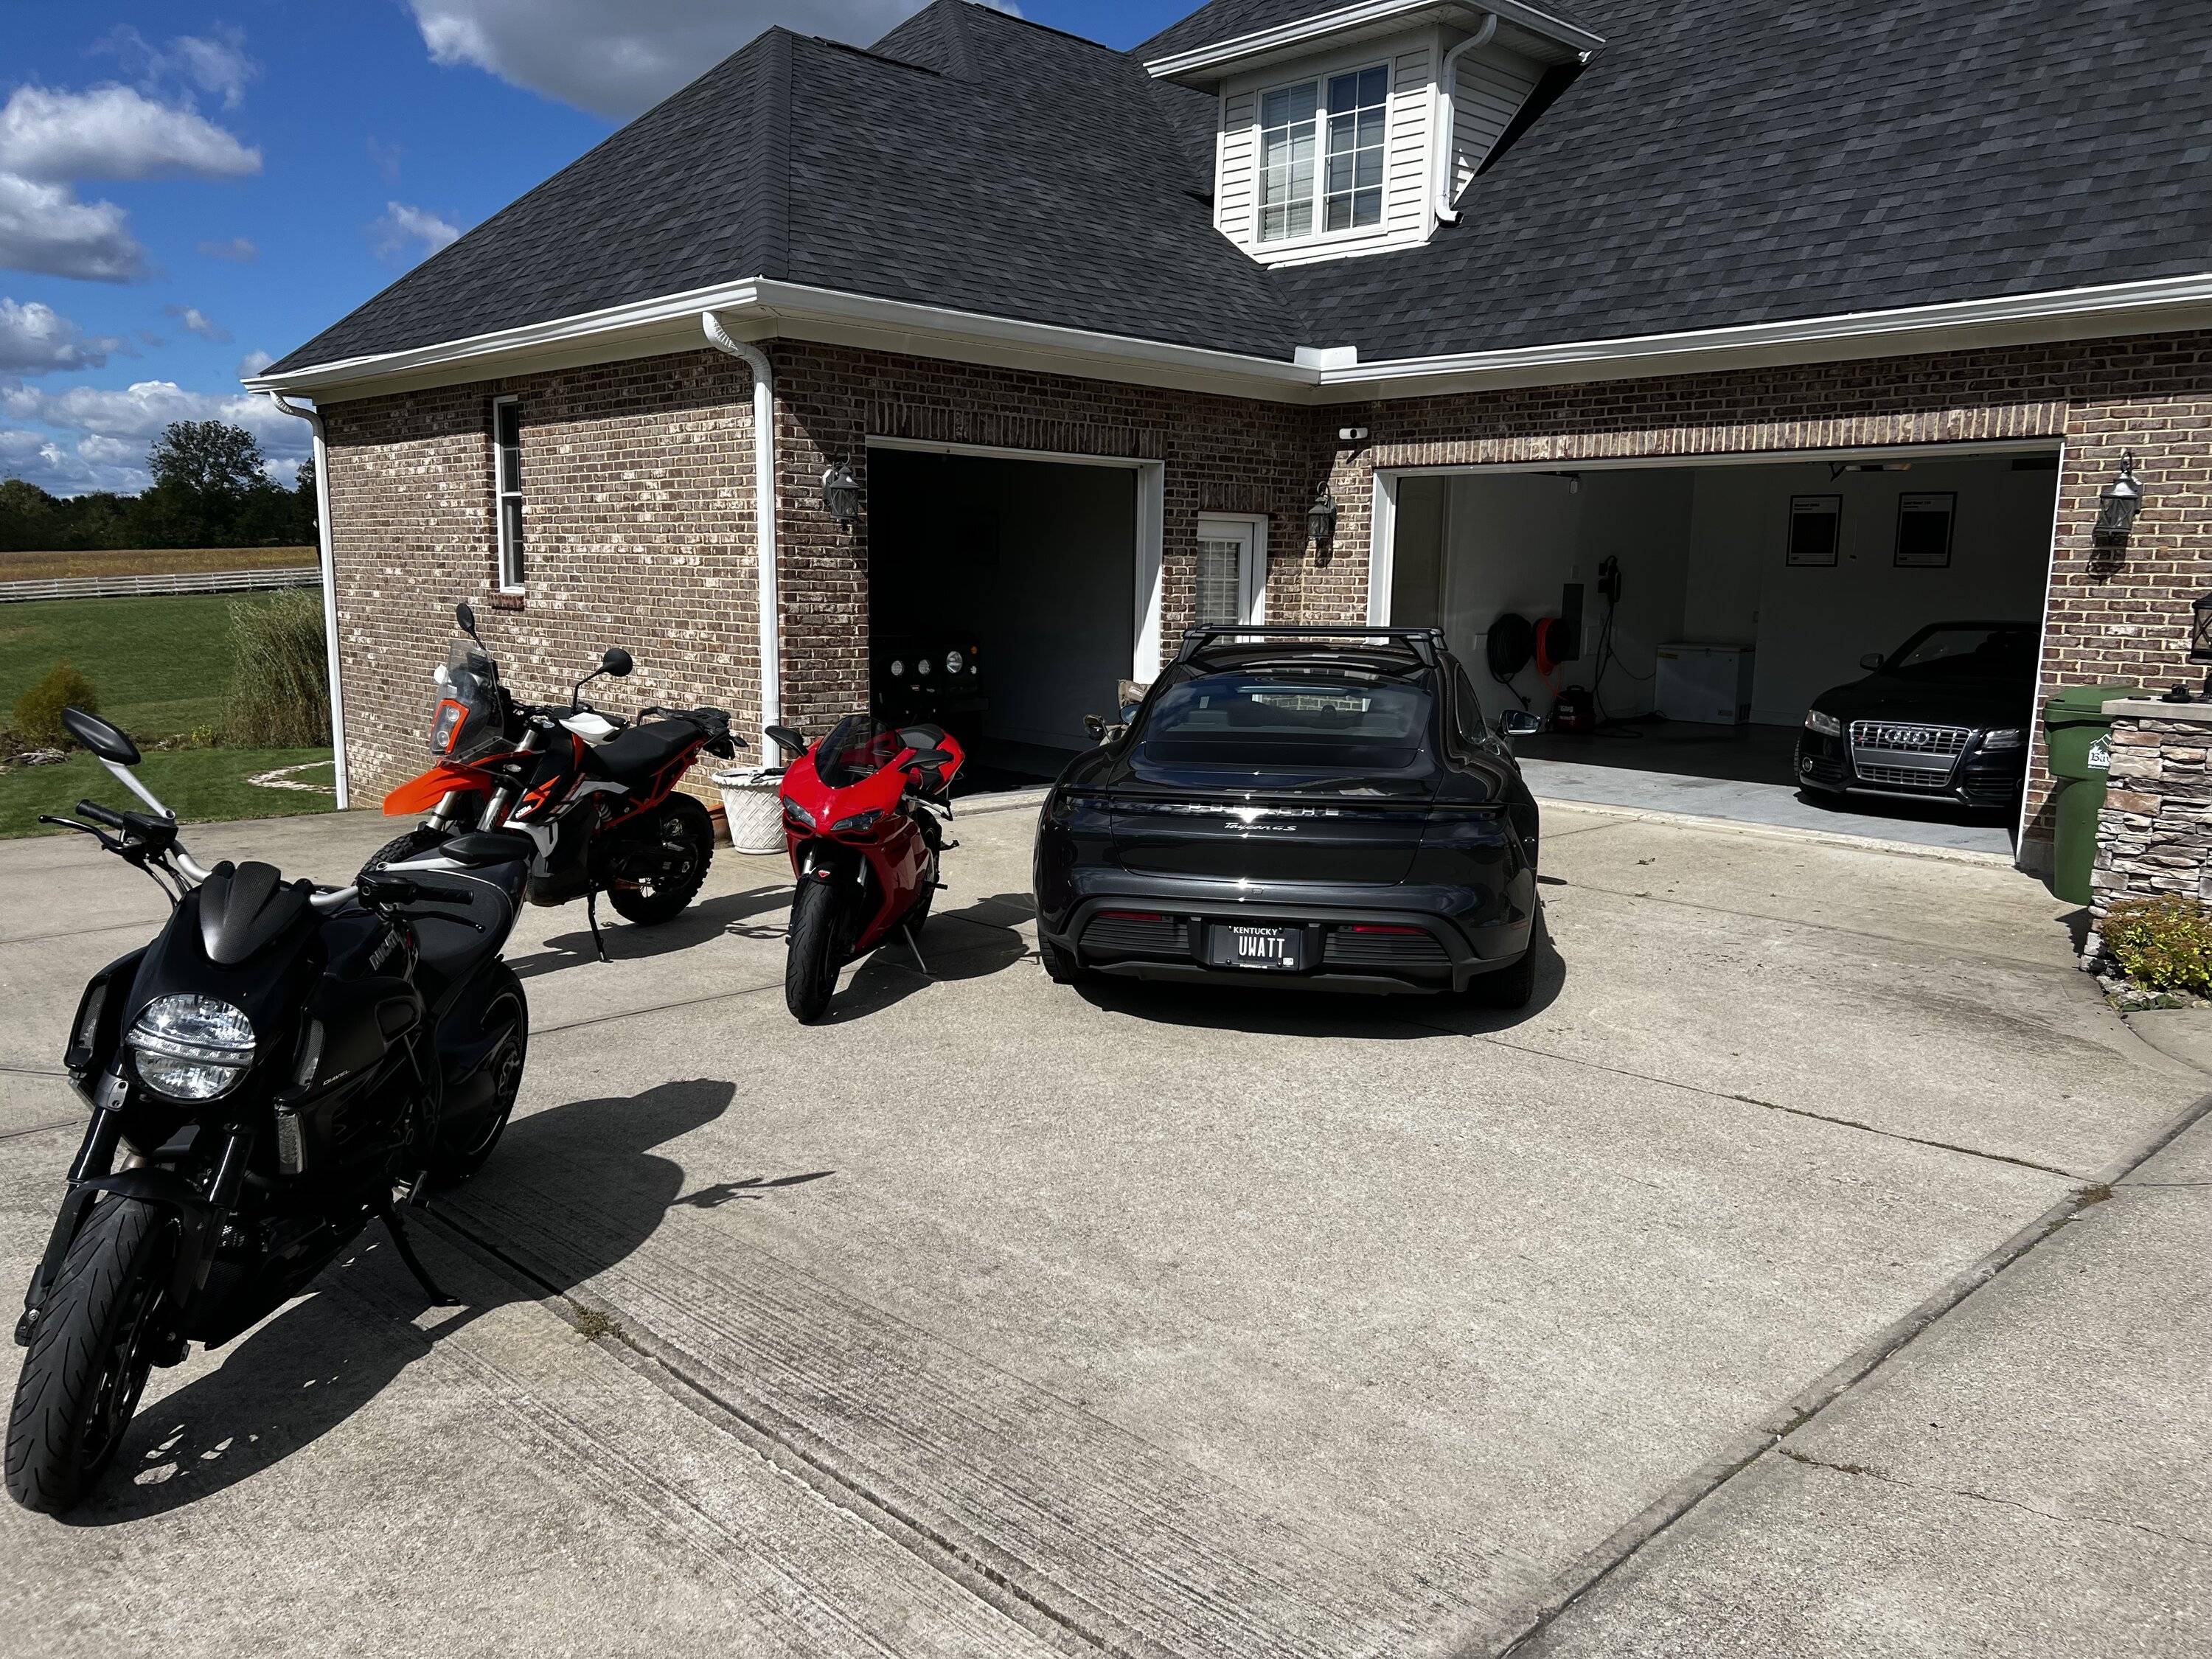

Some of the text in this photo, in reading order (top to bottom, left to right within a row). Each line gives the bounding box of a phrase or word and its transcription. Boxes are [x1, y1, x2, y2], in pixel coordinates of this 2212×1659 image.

[1189, 803, 1339, 816] POCHE
[1224, 822, 1271, 831] Taycan
[1234, 927, 1278, 936] KENTUCKY
[1239, 936, 1285, 958] UWATT
[323, 1070, 352, 1085] DIAVEL
